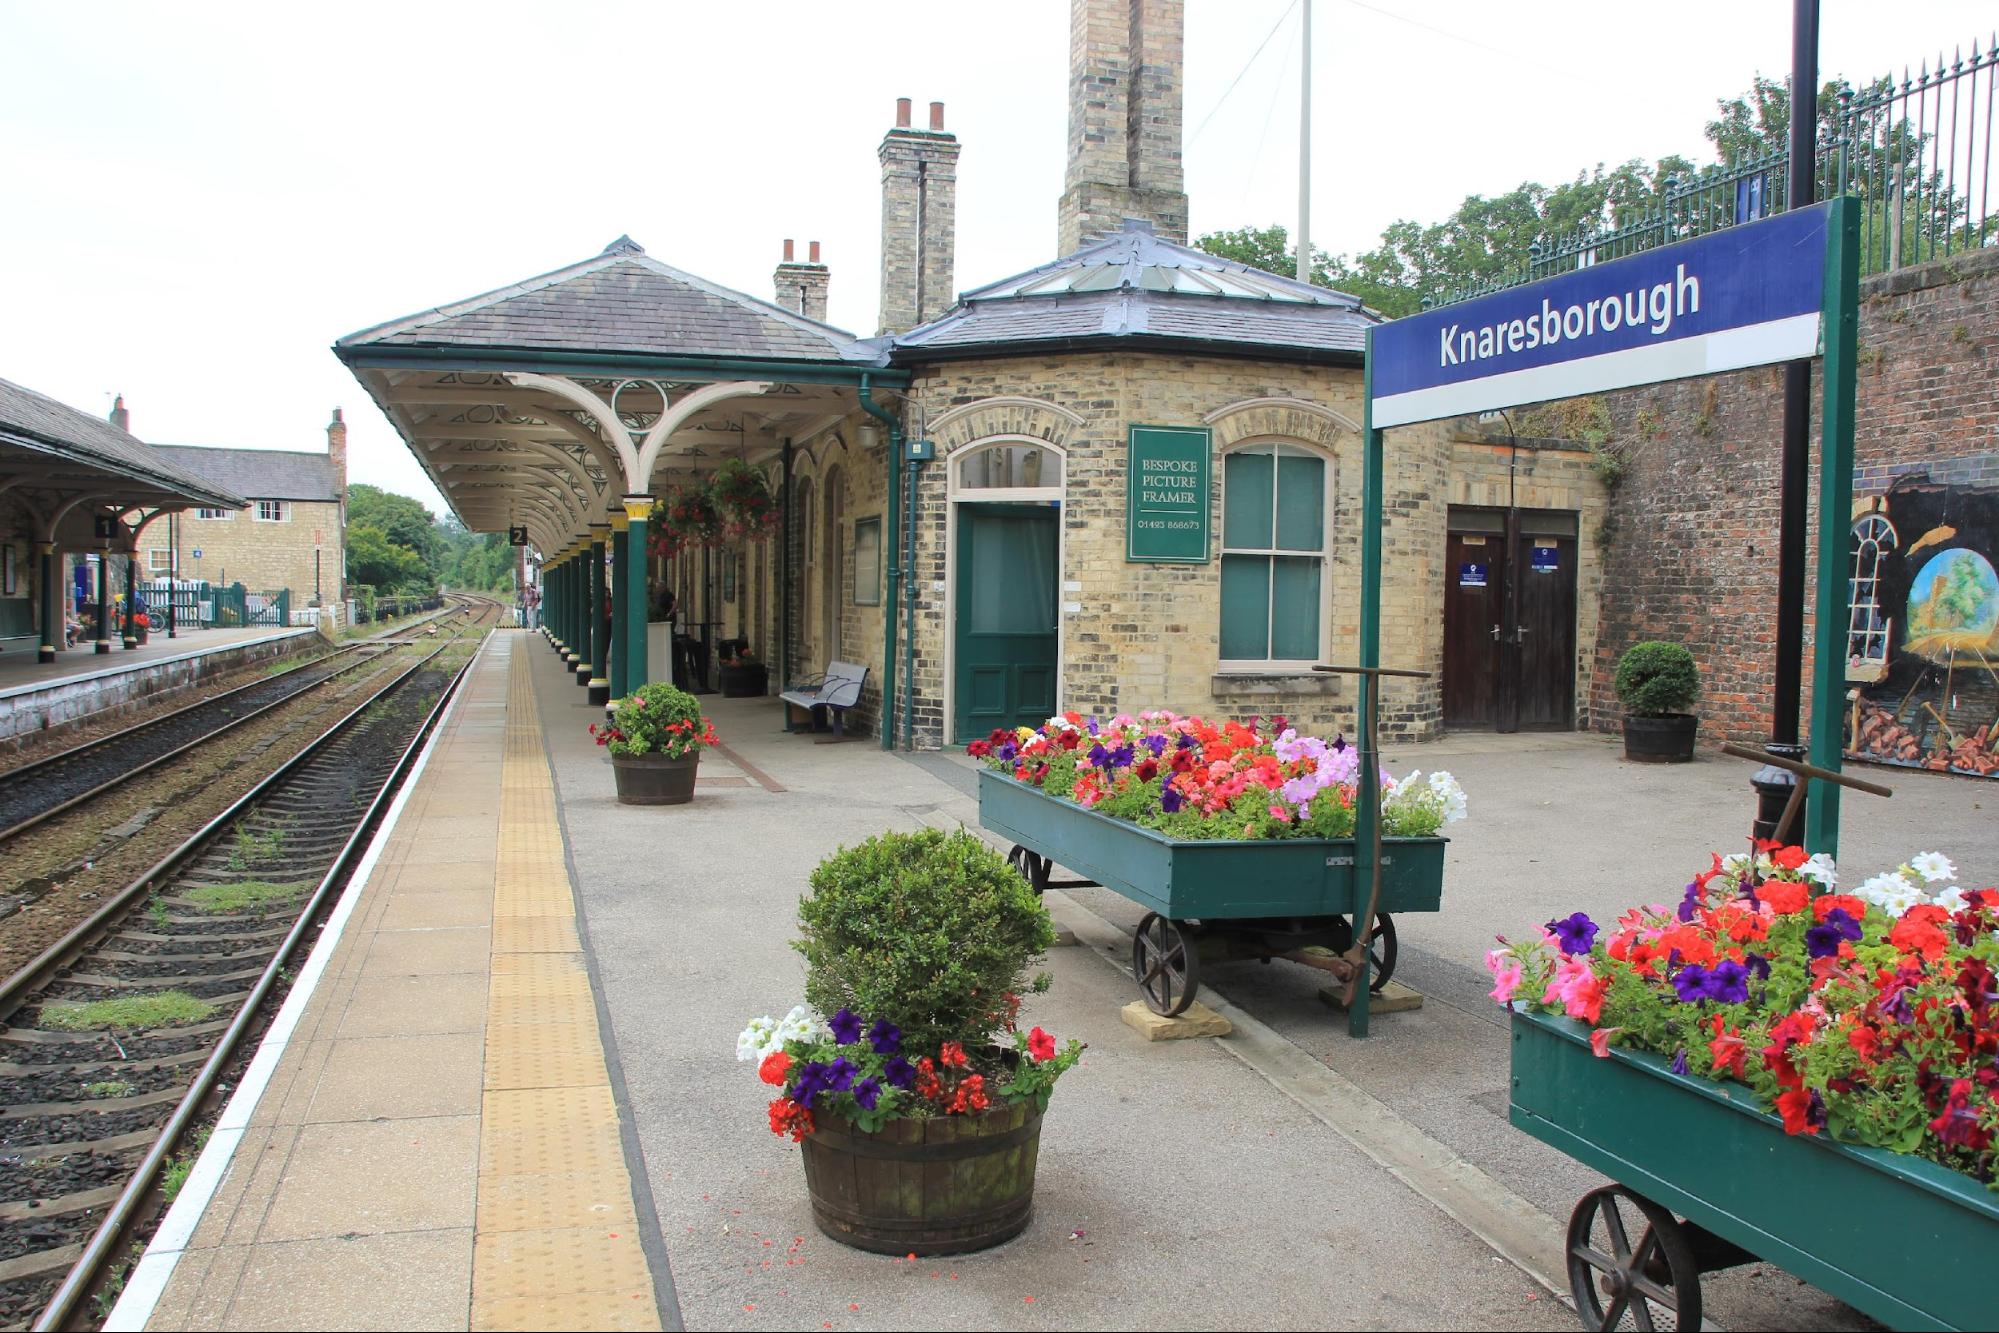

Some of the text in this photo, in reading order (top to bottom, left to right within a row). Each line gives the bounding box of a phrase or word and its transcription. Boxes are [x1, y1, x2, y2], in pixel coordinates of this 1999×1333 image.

[1440, 264, 1699, 367] Knaresborough
[1142, 459, 1198, 473] BESPOKE
[1142, 475, 1197, 488] PICTURE
[1142, 491, 1196, 504] FRAMER
[101, 519, 110, 535] 1
[513, 530, 524, 543] 2
